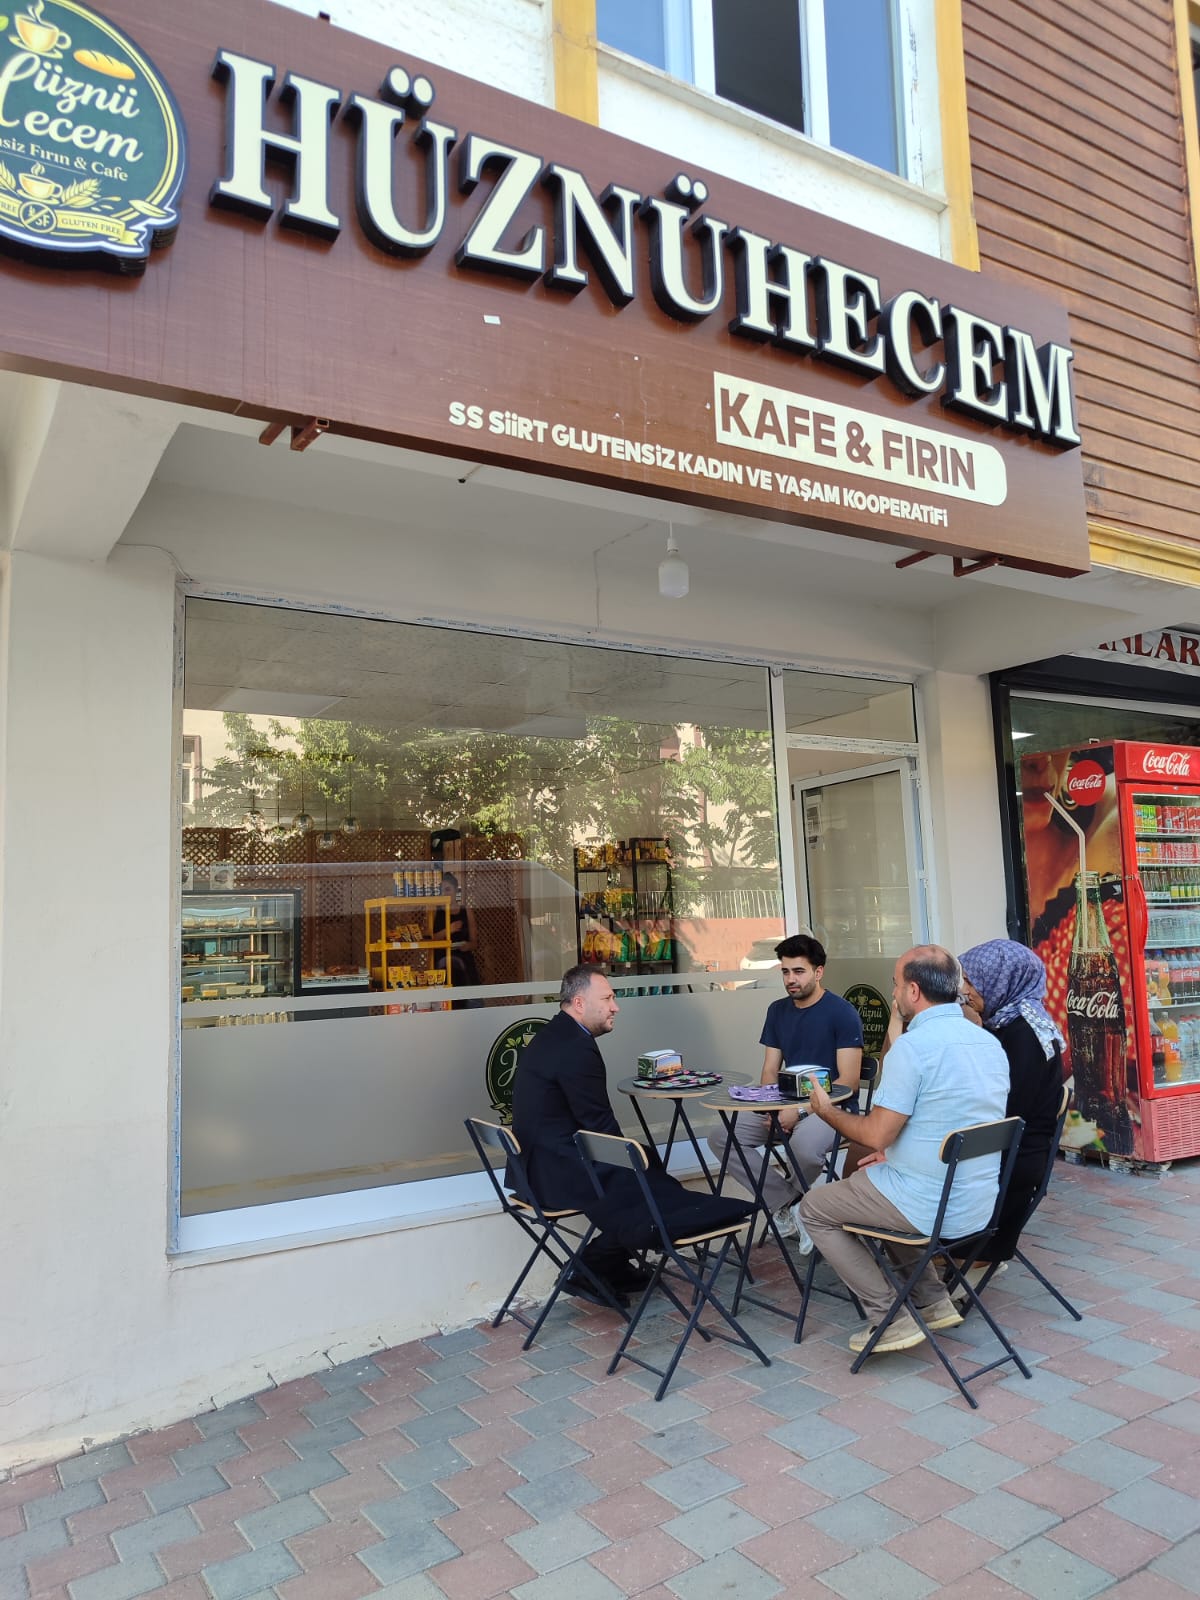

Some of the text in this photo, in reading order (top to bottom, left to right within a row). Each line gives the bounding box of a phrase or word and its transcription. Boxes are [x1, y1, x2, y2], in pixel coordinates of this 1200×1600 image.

[74, 156, 87, 171] &
[91, 161, 128, 181] Cafe
[61, 217, 122, 236] GLUTEN FREE
[213, 47, 1081, 447] HÜZNÜHECEM
[449, 402, 484, 430] SS
[678, 451, 744, 485] KADIN
[746, 465, 772, 491] VE
[775, 472, 840, 504] YAŞAM
[720, 388, 976, 491] KAFE & FIRIN
[1143, 749, 1190, 777] Coca-Cola
[1069, 774, 1103, 791] Coca-Cola
